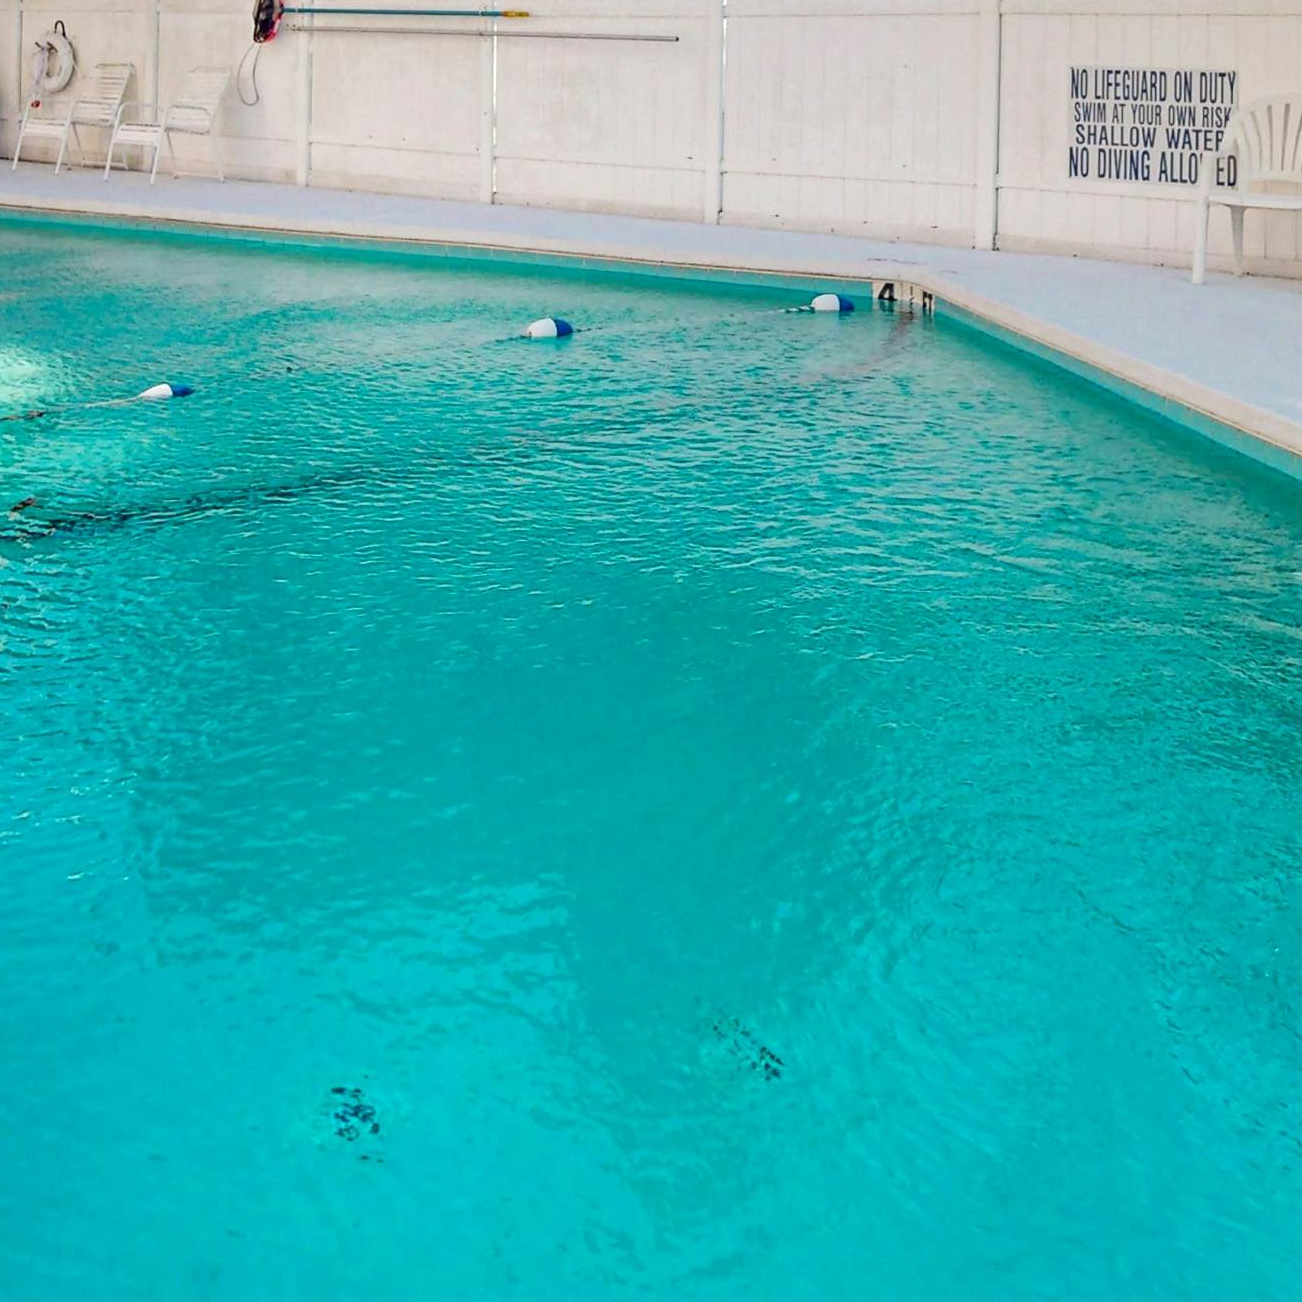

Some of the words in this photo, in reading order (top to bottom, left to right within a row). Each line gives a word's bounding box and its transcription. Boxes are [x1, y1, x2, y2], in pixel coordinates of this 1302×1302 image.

[1071, 68, 1088, 99] NO
[1094, 69, 1167, 102] LIFEGUARD
[1174, 71, 1192, 103] ON
[1199, 71, 1236, 104] DUTY
[1074, 101, 1106, 123] SWIM
[1112, 103, 1126, 124] AT
[1131, 104, 1162, 126] YOUR
[1168, 106, 1196, 127] OWN
[1202, 107, 1231, 128] RISK
[1076, 124, 1156, 148] SHALLOW
[1069, 147, 1089, 178] NO
[1098, 148, 1151, 182] DIVING
[1159, 151, 1237, 187] ALLOED
